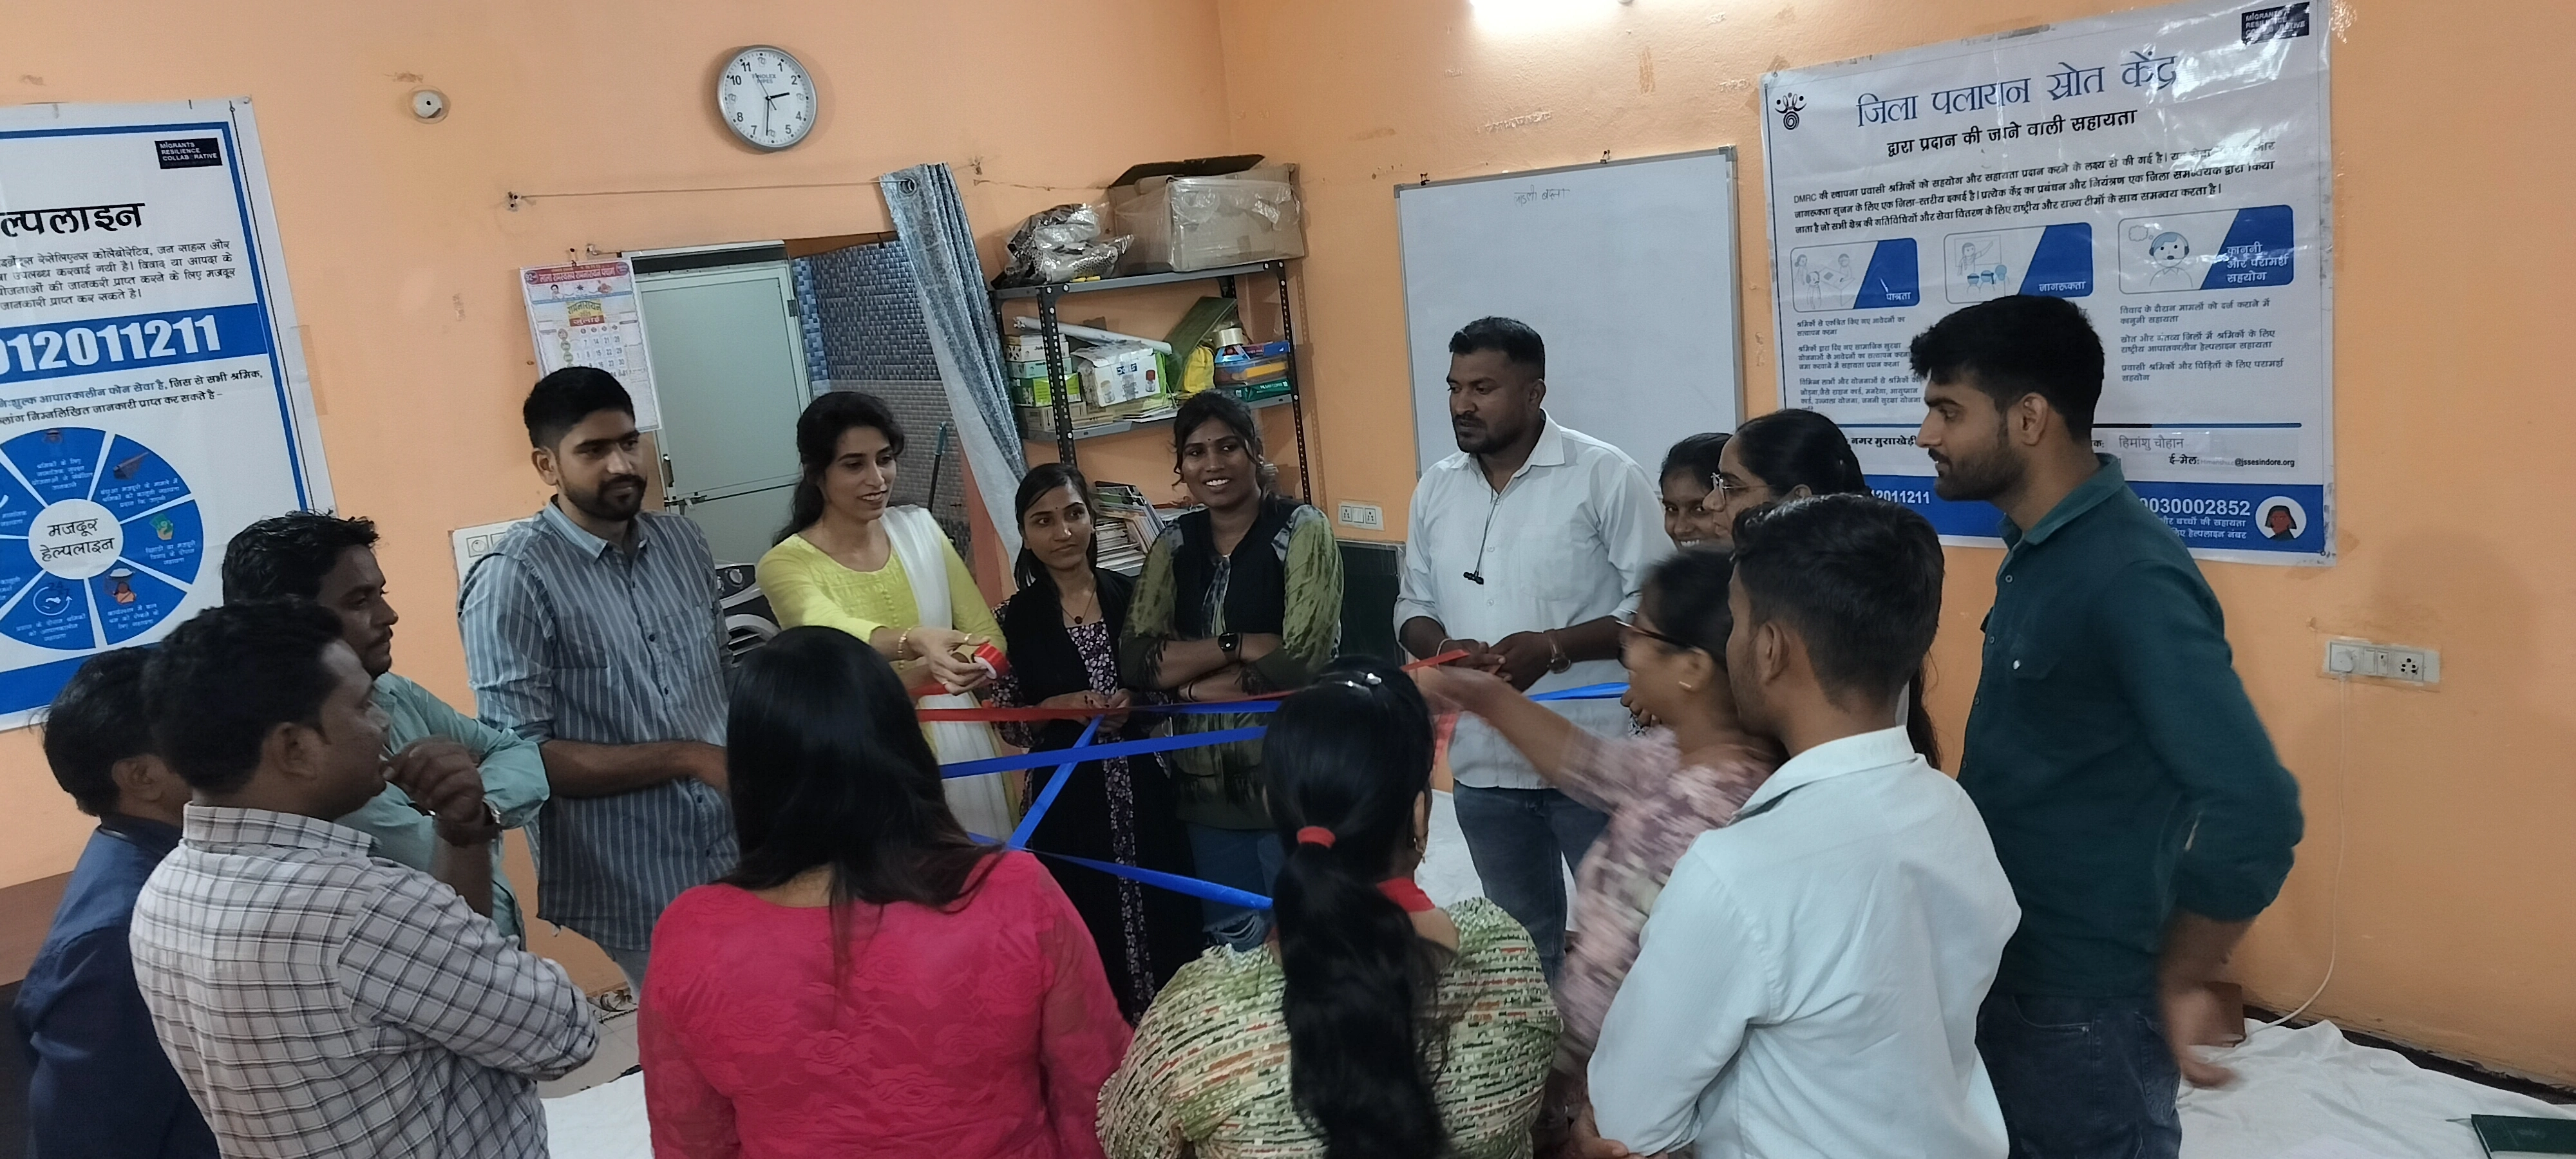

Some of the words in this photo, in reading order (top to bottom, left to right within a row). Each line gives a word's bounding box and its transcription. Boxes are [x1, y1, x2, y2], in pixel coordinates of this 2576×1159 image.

[741, 62, 752, 71] 11
[777, 62, 783, 71] 1
[730, 75, 742, 85] 10
[790, 75, 797, 85] 2
[1856, 93, 1918, 127] जिला
[1931, 77, 2031, 115] पलायन
[2046, 62, 2105, 100] स्रोत
[2121, 50, 2177, 91] केंद्र
[737, 111, 743, 122] 8
[795, 111, 802, 121] 4
[751, 125, 757, 135] 7
[785, 124, 791, 134] 5
[1888, 140, 1914, 157] द्वारा
[1919, 133, 1957, 151] प्रदान
[1963, 127, 1983, 146] की
[1988, 123, 2021, 142] जाने
[2028, 116, 2066, 137] वाली
[2071, 109, 2137, 131] सहायता
[1794, 193, 1817, 203] DMRC
[1819, 190, 1828, 200] की
[1861, 183, 1886, 196] प्रवासी
[1888, 180, 1916, 192] श्रमिकों
[1918, 178, 1929, 189] को
[1932, 175, 1964, 187] सहयोग
[1966, 173, 1983, 184] और
[1985, 170, 2019, 182] सहायता
[2022, 167, 2045, 178] प्रदान
[2047, 162, 2070, 174] करने
[2072, 161, 2081, 172] के
[2108, 157, 2118, 167] से
[2122, 155, 2135, 166] की
[2137, 152, 2154, 165] गई
[1794, 207, 1832, 219] जागरूकता
[1833, 205, 1853, 217] सृजन
[1855, 202, 1862, 212] के
[1864, 202, 1879, 212] लिए
[1881, 200, 1893, 211] एक
[1982, 187, 2007, 199] प्रत्येक
[2023, 184, 2035, 194] का
[2037, 181, 2067, 193] प्रबंधन
[2069, 178, 2087, 189] और
[2089, 174, 2125, 188] नियंत्रण
[2128, 174, 2143, 184] एक
[2146, 171, 2170, 182] जिला
[2224, 164, 2244, 176] द्वारा
[1795, 224, 1813, 234] जाता
[1814, 221, 1819, 233] है
[1820, 221, 1830, 232] जो
[1832, 220, 1848, 231] सभी
[1863, 218, 1873, 227] की
[1920, 211, 1935, 222] और
[1937, 211, 1953, 221] सेवा
[1955, 207, 1983, 218] वितरण
[1985, 205, 1994, 216] के
[1995, 203, 2011, 215] लिए
[2013, 201, 2040, 214] राष्ट्रीय
[2041, 198, 2058, 209] और
[2060, 198, 2081, 209] राज्य
[2084, 194, 2105, 206] टीमों
[2107, 194, 2117, 204] के
[2140, 189, 2179, 201] समन्वय
[2181, 185, 2207, 196] करता
[0, 202, 146, 238] ल्पलाइन
[156, 245, 175, 254] जन
[177, 242, 206, 252] साहस
[210, 238, 230, 250] और
[56, 263, 91, 277] करवाई
[95, 261, 116, 273] गयी
[138, 259, 166, 270] विवाद
[171, 258, 183, 267] या
[187, 255, 218, 265] आपदा
[222, 252, 232, 262] के
[48, 280, 63, 291] की
[113, 276, 135, 287] प्राप्त
[140, 272, 164, 283] करने
[169, 270, 179, 281] के
[184, 269, 202, 281] लिए
[206, 267, 236, 279] मजदूर
[2226, 270, 2267, 283] सहयोग
[2039, 281, 2087, 293] जागरूकता
[0, 296, 46, 310] जानकारी
[50, 296, 73, 307] प्राप्त
[77, 294, 94, 303] कर
[98, 289, 126, 301] सकते
[1886, 292, 1911, 301] पात्रता
[39, 387, 106, 403] आपातकालीन
[108, 384, 131, 395] फोन
[133, 382, 155, 392] सेवा
[169, 377, 192, 388] जिस
[194, 375, 204, 385] से
[206, 372, 227, 384] सभी
[26, 406, 90, 422] निम्नलिखित
[92, 398, 137, 413] जानकारी
[138, 397, 162, 408] प्राप्त
[163, 395, 180, 404] कर
[180, 390, 206, 402] सकते
[2119, 435, 2152, 450] हिमांशु
[2154, 434, 2184, 449] चौहान
[47, 518, 98, 536] मजदूर
[2201, 517, 2211, 525] की
[2213, 518, 2246, 527] सहायता
[2188, 528, 2224, 538] हेल्पलाइन
[2227, 531, 2246, 539] नंबर
[40, 538, 115, 561] हेल्पलाइन
